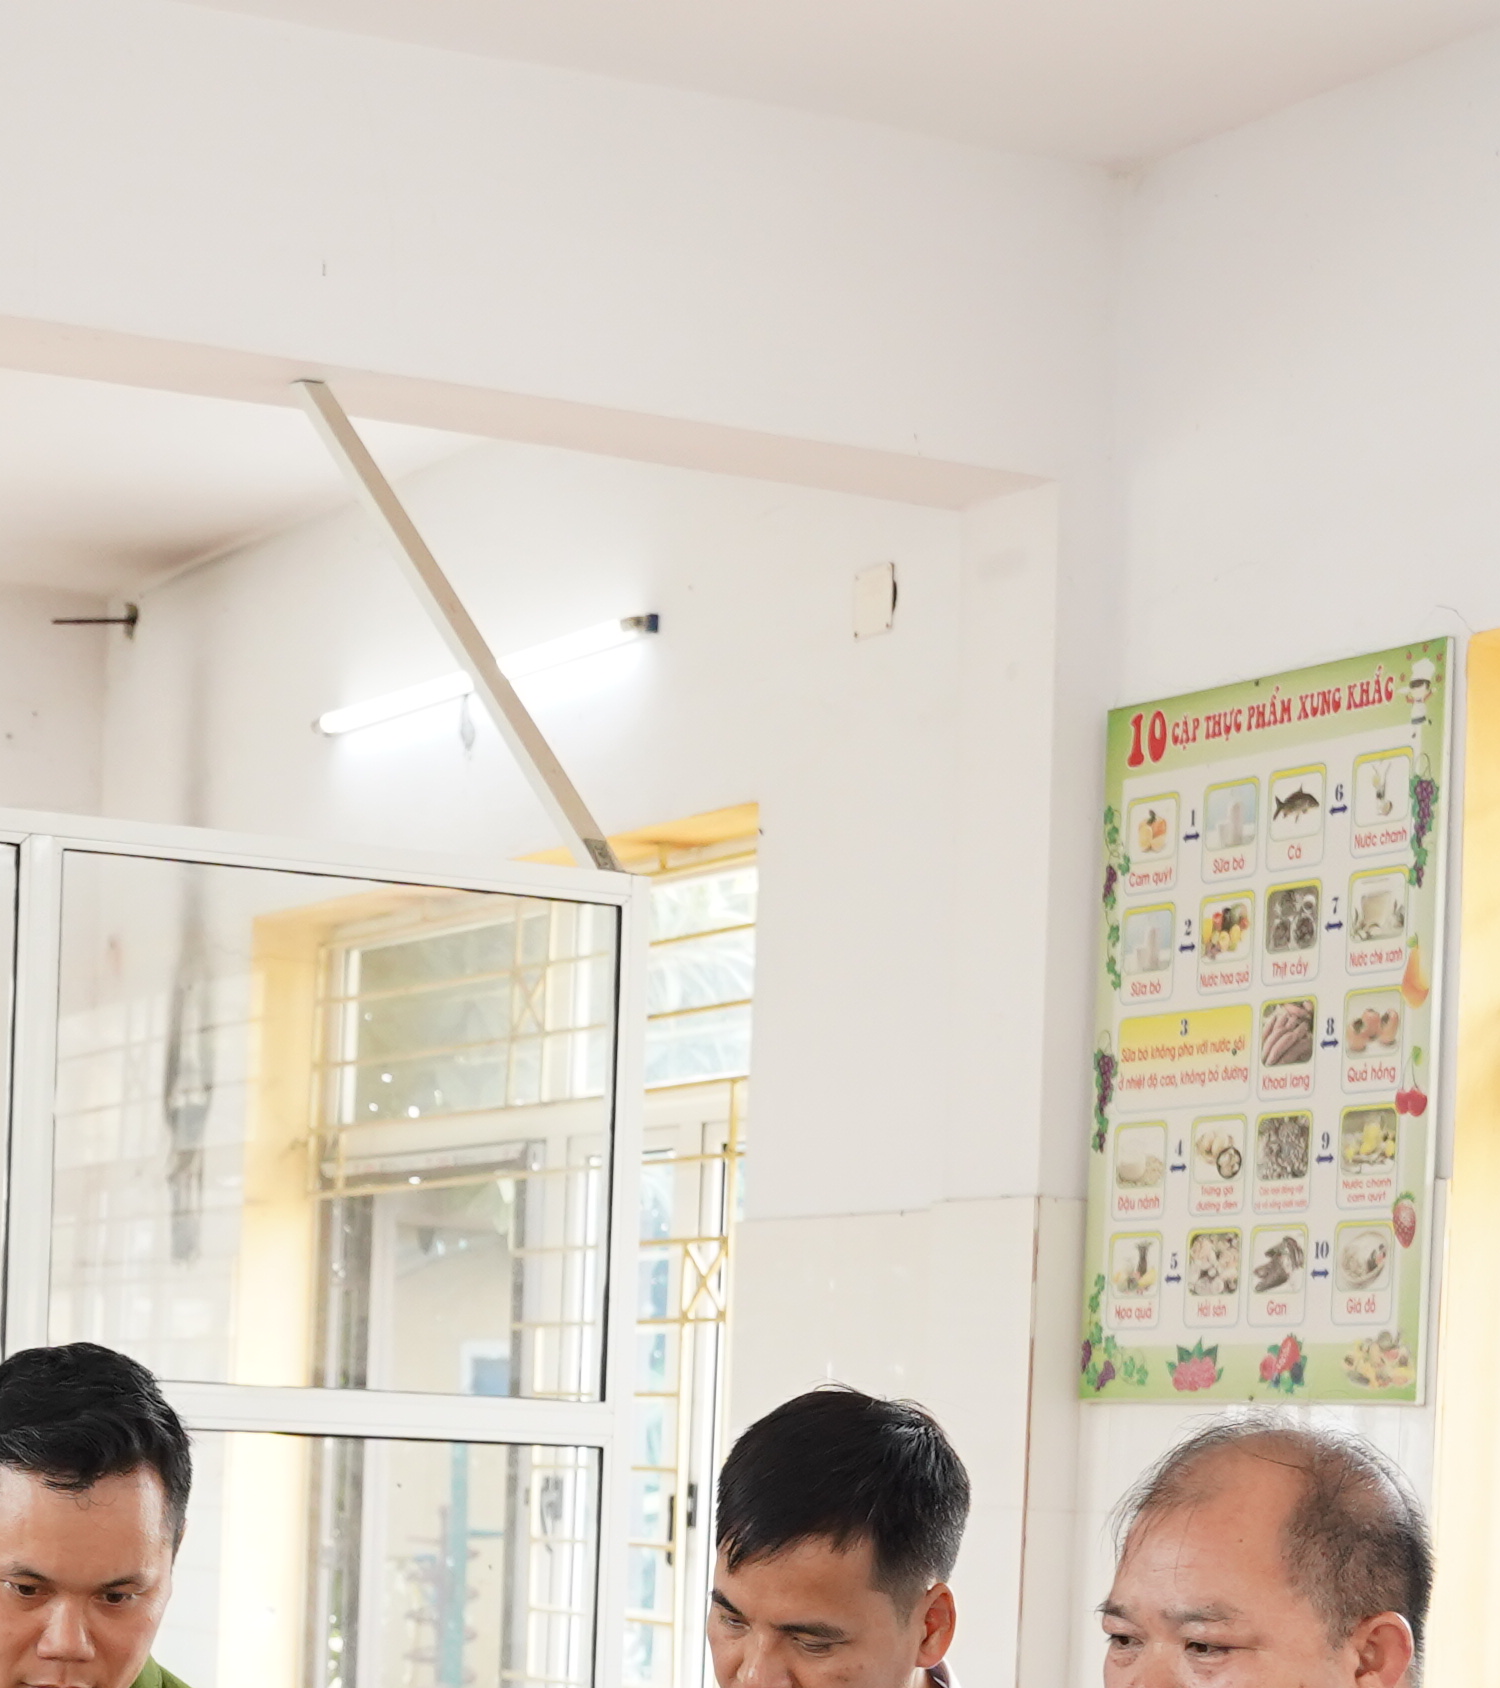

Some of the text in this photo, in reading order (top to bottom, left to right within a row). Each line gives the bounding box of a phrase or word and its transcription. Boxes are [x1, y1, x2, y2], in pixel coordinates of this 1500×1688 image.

[1127, 665, 1395, 769] 10 CẶP THỰC PHẨM XUNG KHẮC
[1335, 784, 1344, 801] 6
[1379, 827, 1408, 846] chanh
[1129, 872, 1150, 888] Cam
[1331, 897, 1340, 914] 7
[1184, 919, 1192, 936] 2
[1180, 1019, 1188, 1036] 3
[1326, 1017, 1334, 1035] 8
[1321, 1132, 1330, 1150] 9
[1315, 1241, 1329, 1259] 10
[1170, 1252, 1178, 1270] 5
